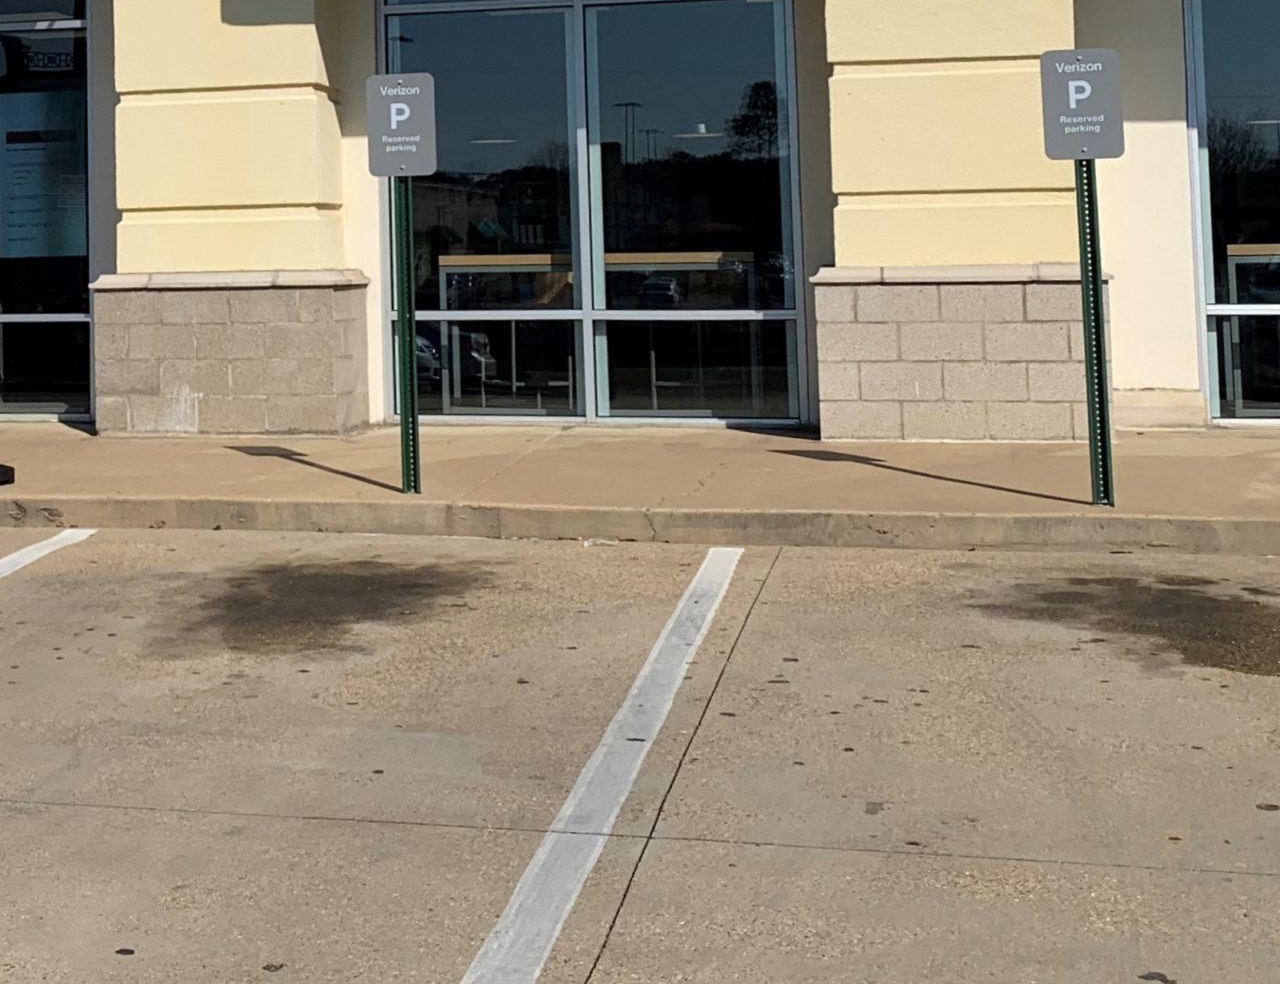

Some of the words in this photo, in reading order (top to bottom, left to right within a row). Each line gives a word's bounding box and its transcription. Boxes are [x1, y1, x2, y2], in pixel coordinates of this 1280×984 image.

[1055, 62, 1103, 73] Verizon
[380, 86, 420, 96] Verizon
[1068, 80, 1092, 109] P
[390, 103, 410, 130] P
[1060, 114, 1104, 124] Reserved
[1064, 125, 1100, 134] parking
[382, 135, 420, 143] Reserved
[386, 144, 416, 152] parking
